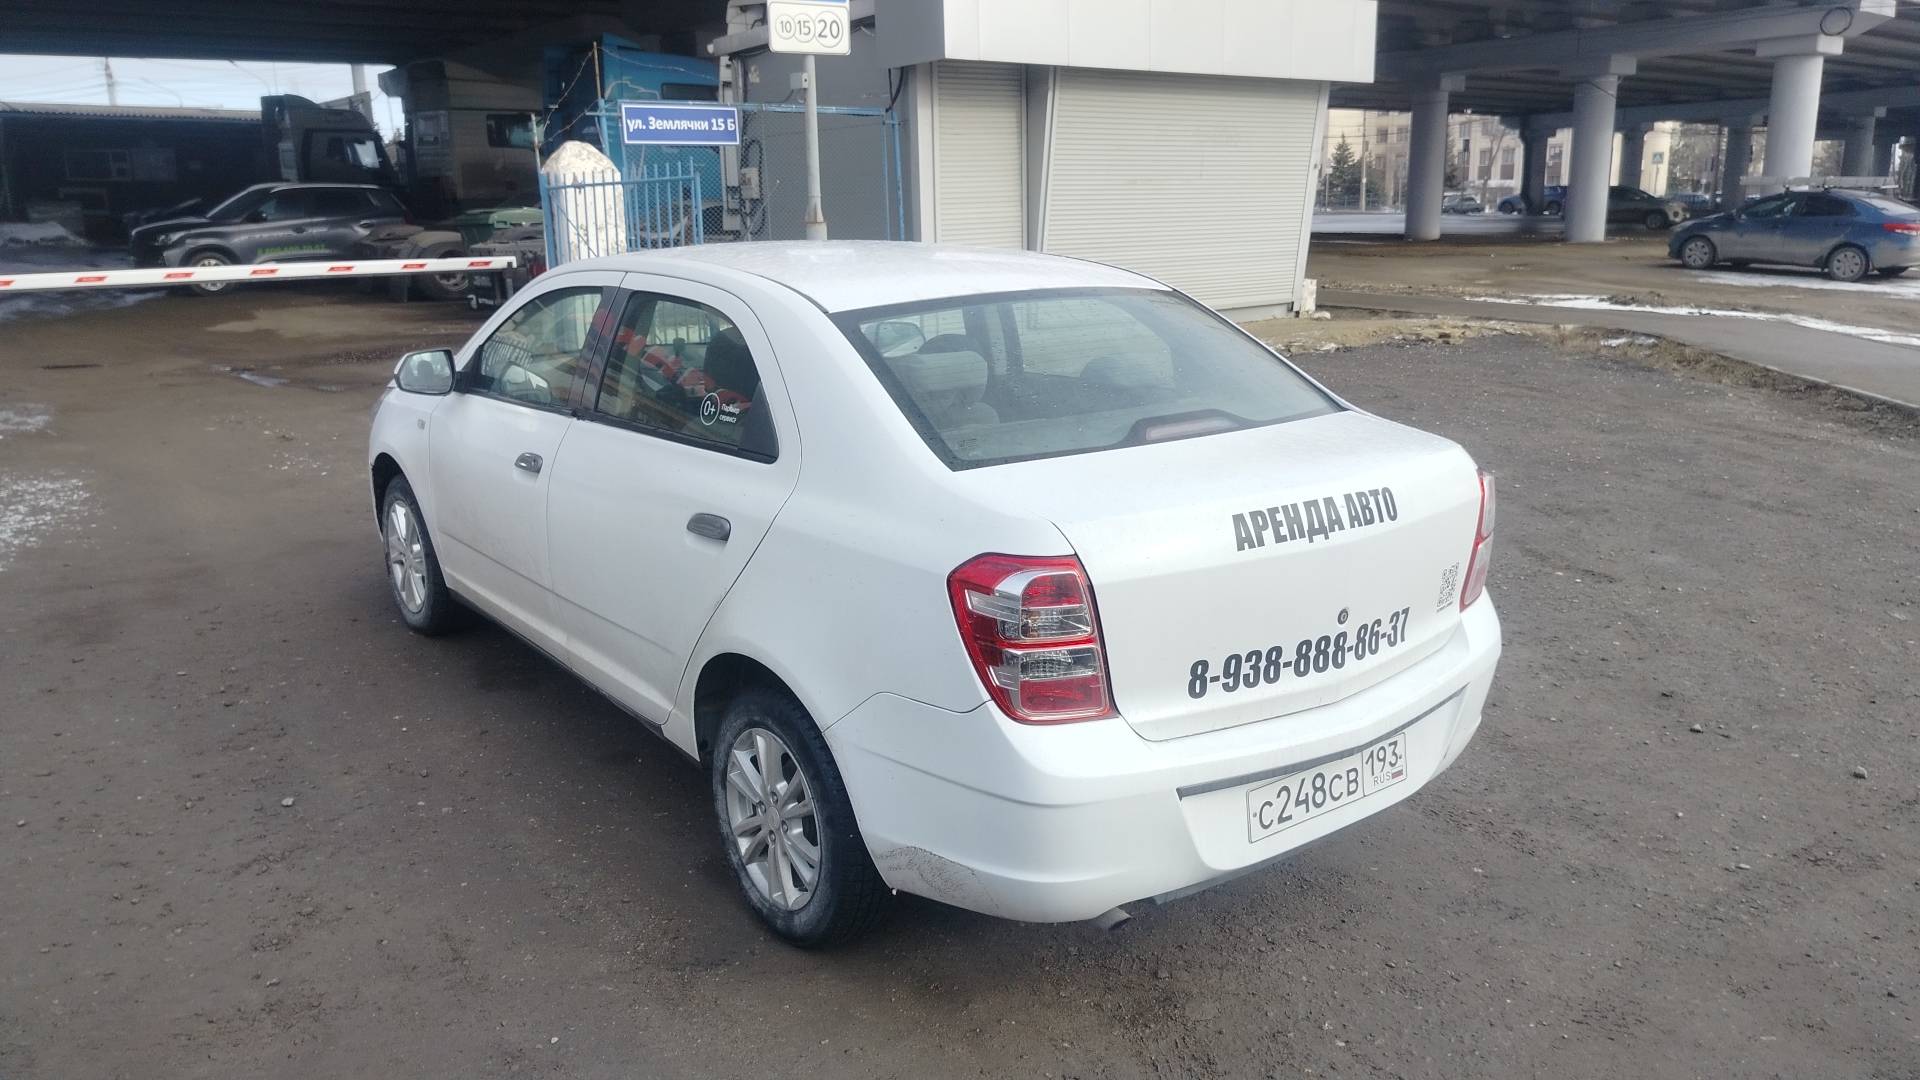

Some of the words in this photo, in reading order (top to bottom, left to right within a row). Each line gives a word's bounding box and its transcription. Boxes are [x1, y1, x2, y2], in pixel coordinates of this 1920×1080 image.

[780, 20, 792, 33] 10
[797, 20, 811, 36] 15
[818, 19, 840, 39] 20
[627, 118, 646, 132] ул.
[647, 116, 709, 131] Землячки
[711, 118, 726, 131] 15
[727, 119, 736, 131] Б
[703, 401, 716, 416] 0+
[1232, 496, 1345, 552] АРЕНДА
[1343, 486, 1398, 529] АВТО
[1187, 606, 1411, 700] 8-938-888-86-37
[1365, 740, 1399, 777] 193
[1373, 771, 1391, 786] RUS
